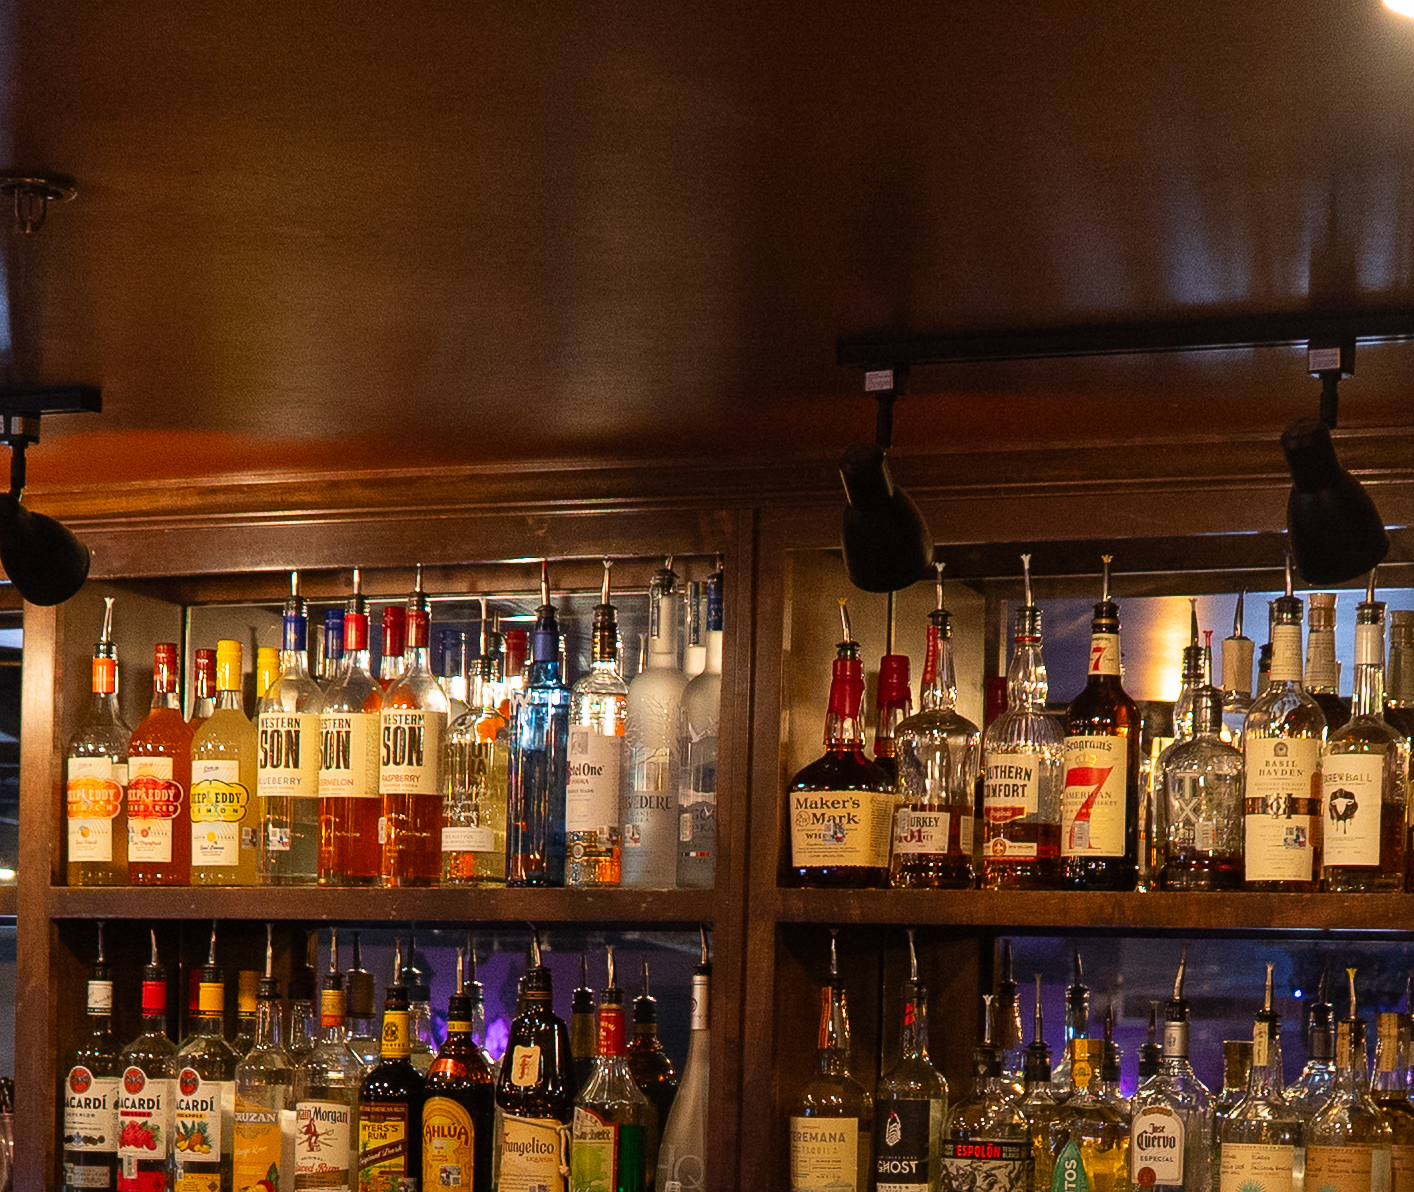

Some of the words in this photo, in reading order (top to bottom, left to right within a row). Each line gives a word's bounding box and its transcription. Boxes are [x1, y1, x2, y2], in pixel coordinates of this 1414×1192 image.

[1092, 646, 1107, 670] 7
[320, 718, 351, 730] ESTERN
[260, 729, 301, 769] SON
[382, 726, 425, 767] SON
[1067, 740, 1113, 752] Seagram's
[567, 761, 582, 776] etel
[583, 762, 603, 776] One
[258, 777, 302, 785] LUEBERRY
[382, 775, 421, 783] RASPBERRY
[89, 789, 115, 800] EDDY
[148, 789, 176, 801] EDDY
[215, 792, 242, 804] EDDY
[795, 797, 861, 810] Maker's
[1064, 765, 1115, 850] 7
[812, 812, 859, 825] Mark
[909, 816, 941, 828] URKEY
[65, 1094, 107, 1110] ACARDÍ
[120, 1094, 162, 1110] ACARDÍ
[176, 1097, 215, 1112] ACARDÍ
[234, 1112, 277, 1123] RUZAN
[313, 1106, 348, 1124] Morgan
[1149, 1123, 1166, 1135] Jose
[367, 1132, 387, 1140] RUM
[791, 1131, 846, 1143] EREMANA
[1136, 1130, 1176, 1151] Cuervo
[1140, 1155, 1175, 1163] ESPECIAL
[878, 1160, 919, 1173] GHOST
